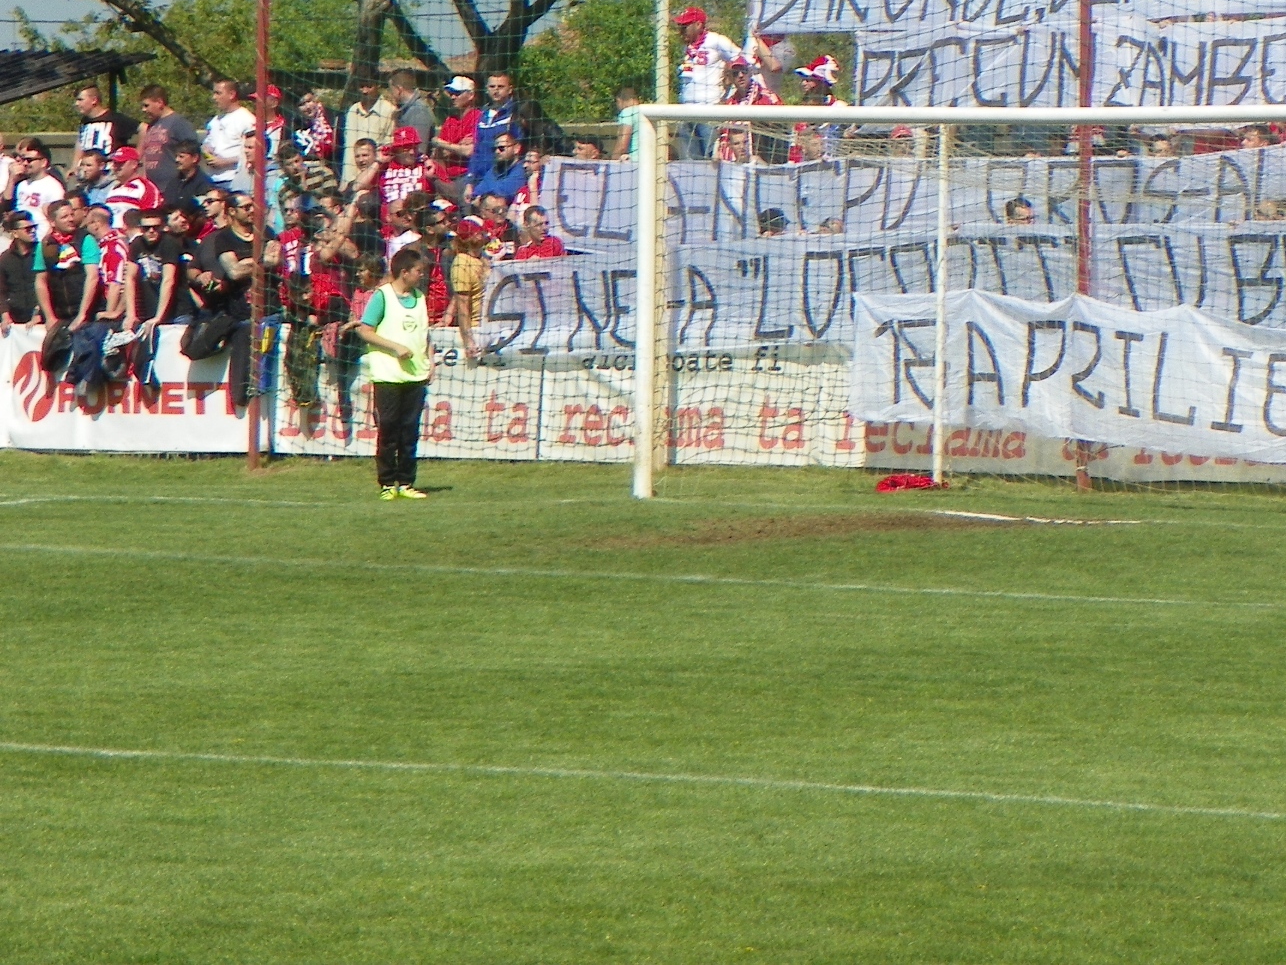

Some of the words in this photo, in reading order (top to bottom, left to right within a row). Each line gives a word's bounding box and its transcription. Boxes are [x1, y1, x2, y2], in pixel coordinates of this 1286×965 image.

[859, 30, 1096, 107] PRECUM
[556, 162, 632, 242] EL
[667, 158, 965, 244] A-NCEPU
[667, 351, 733, 373] oate
[751, 345, 782, 372] fi
[485, 389, 530, 443] ta
[556, 403, 725, 449] recma
[757, 394, 806, 450] ta
